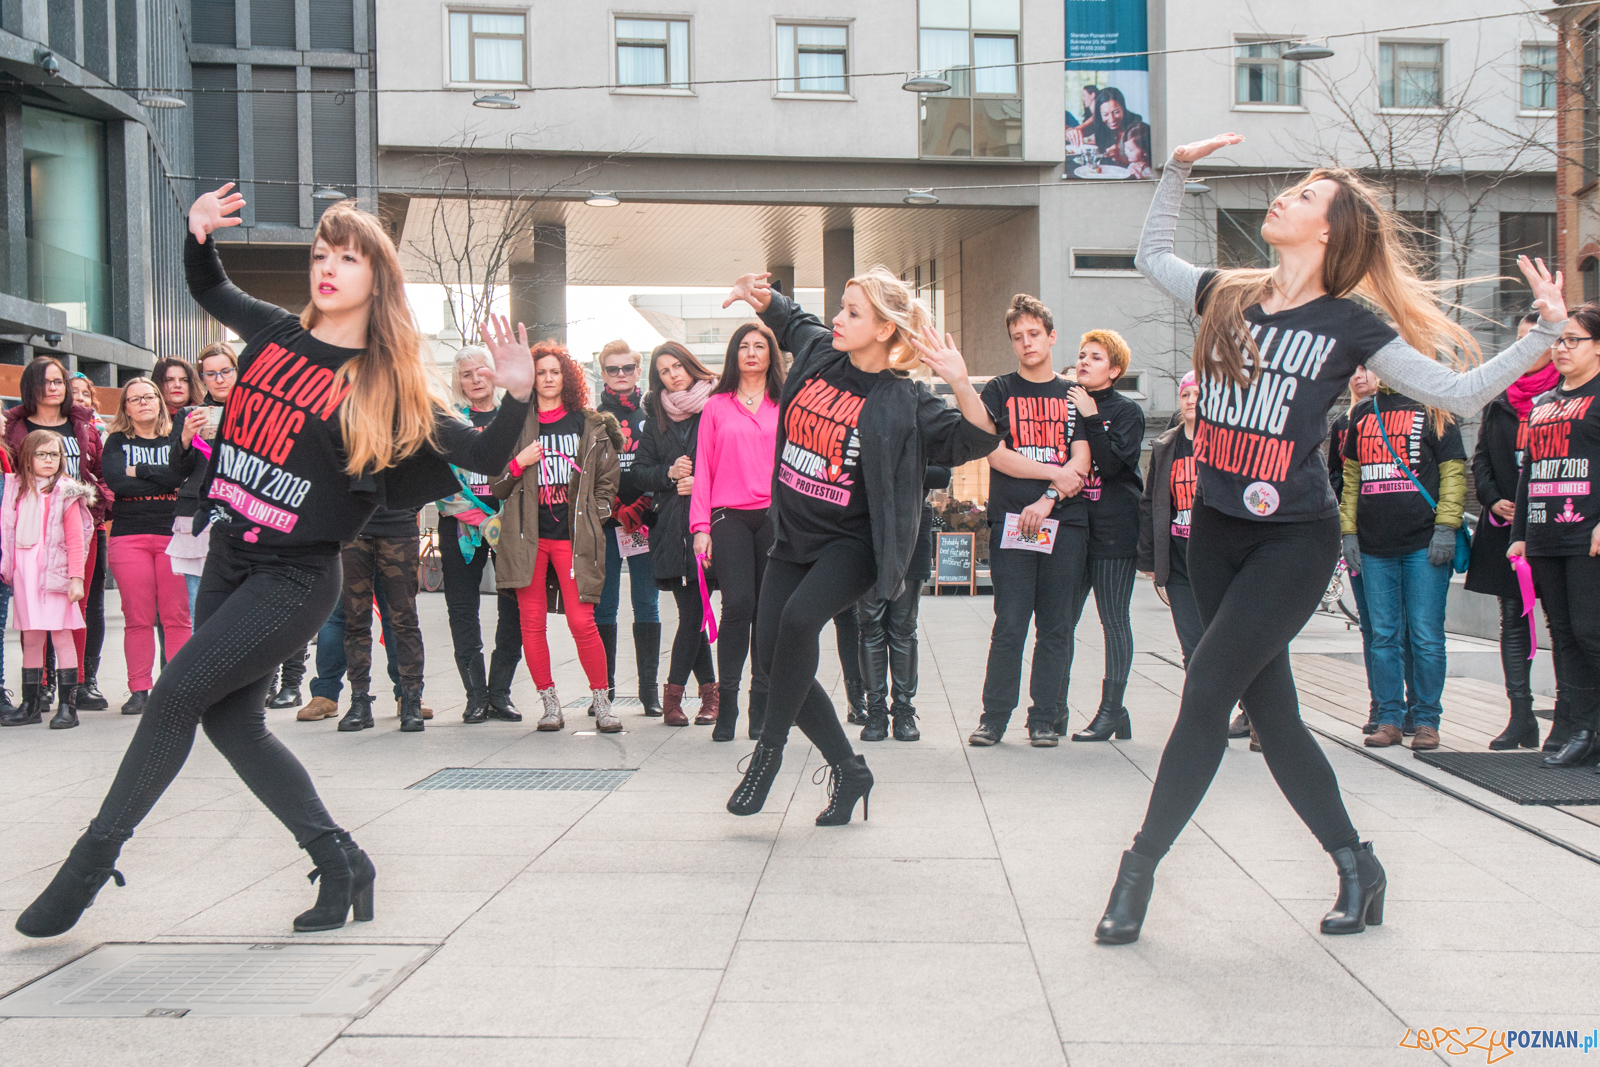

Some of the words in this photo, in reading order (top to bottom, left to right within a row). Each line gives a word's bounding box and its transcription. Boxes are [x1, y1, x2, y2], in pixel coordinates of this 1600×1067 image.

[240, 342, 353, 422] BILLION
[797, 378, 867, 428] BILLION
[1017, 397, 1069, 422] BILLION
[788, 405, 847, 460] RISING
[1019, 421, 1065, 447] RISING
[1561, 458, 1589, 478] 2018
[260, 467, 312, 508] 2018
[795, 477, 844, 503] PROTESTUJ!
[1558, 482, 1587, 493] UNITE!
[247, 499, 292, 529] UNITE!
